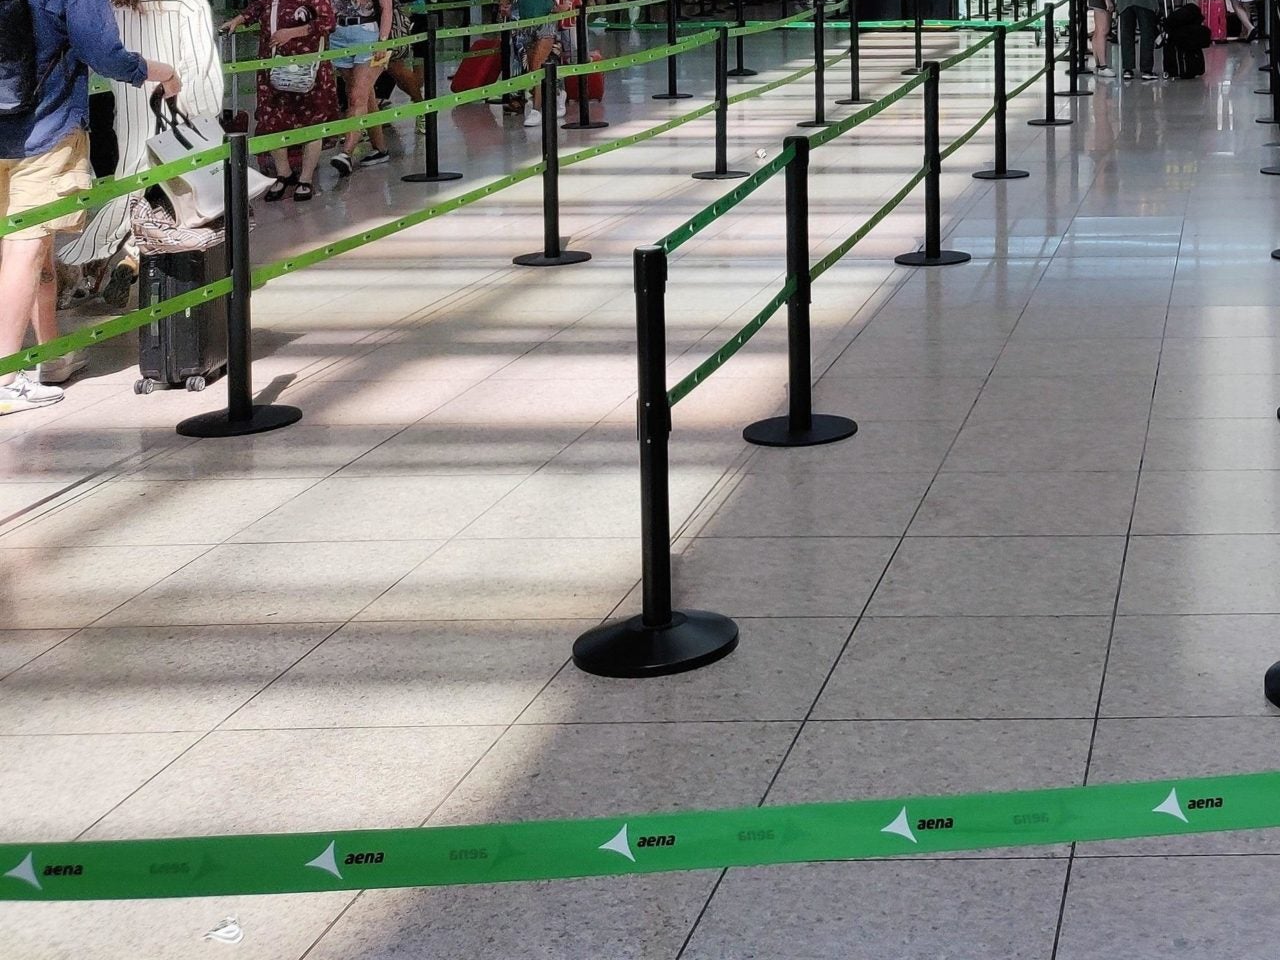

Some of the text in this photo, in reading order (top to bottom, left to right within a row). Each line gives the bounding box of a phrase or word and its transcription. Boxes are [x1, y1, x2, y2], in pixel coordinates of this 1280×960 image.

[1187, 796, 1223, 810] aena
[917, 817, 953, 830] aena
[637, 834, 676, 848] aena
[344, 851, 384, 865] aena
[43, 863, 83, 876] aena
